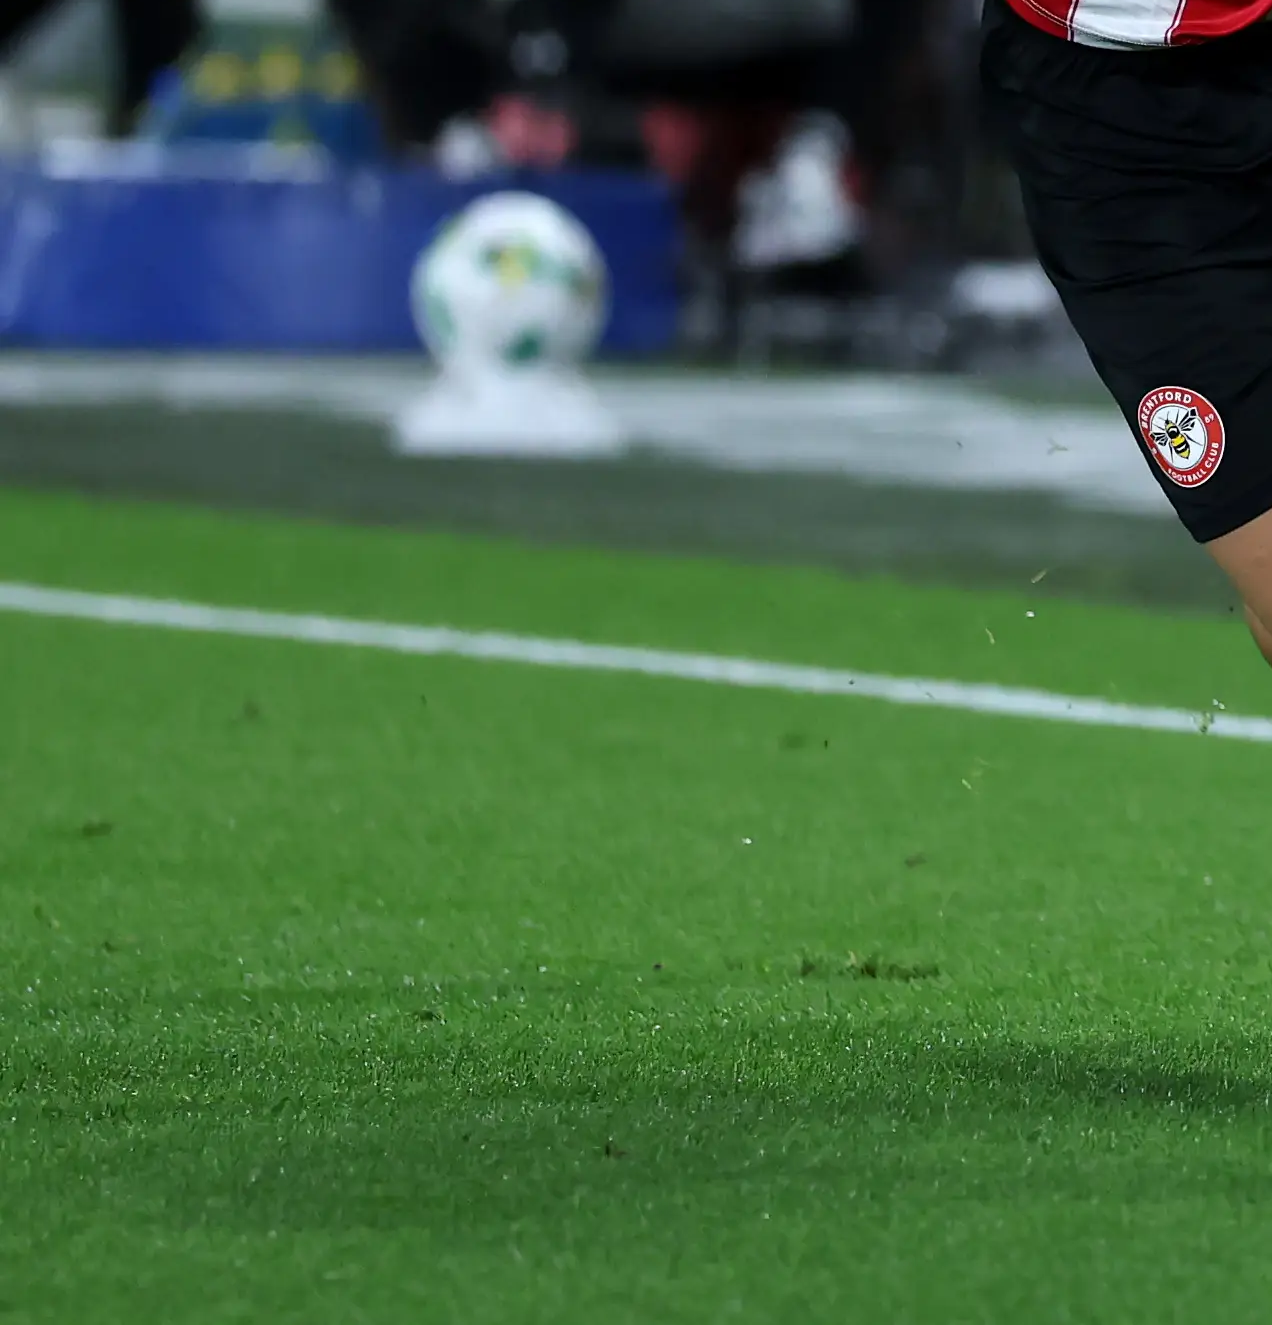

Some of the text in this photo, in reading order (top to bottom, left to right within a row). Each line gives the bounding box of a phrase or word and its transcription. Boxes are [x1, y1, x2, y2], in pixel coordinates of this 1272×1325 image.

[1141, 391, 1192, 429] BRENTFORD
[1167, 442, 1220, 483] FOOTBALL CLUB
